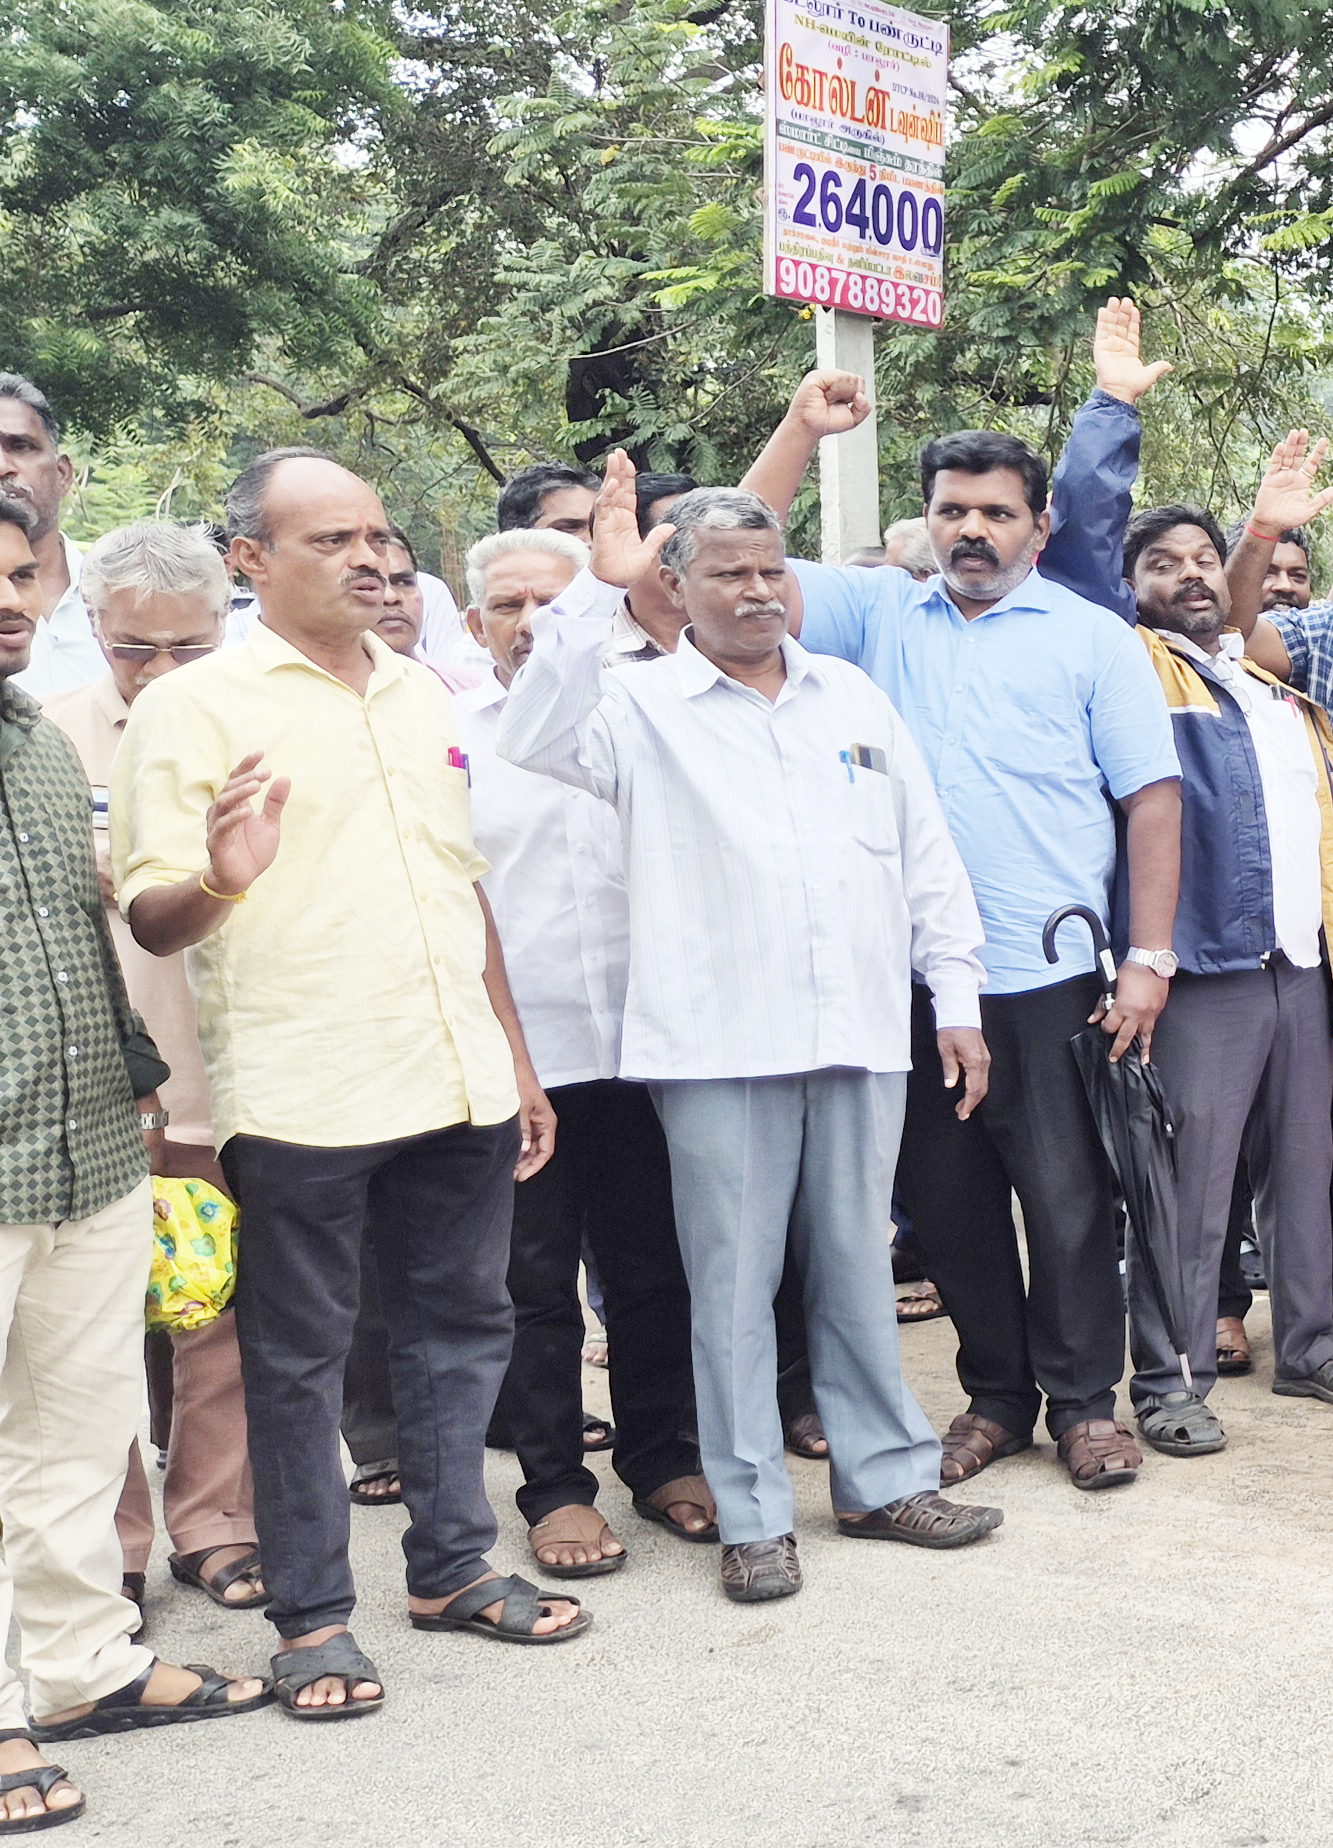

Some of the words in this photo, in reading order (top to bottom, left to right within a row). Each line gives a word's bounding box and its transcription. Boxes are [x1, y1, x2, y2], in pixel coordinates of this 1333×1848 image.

[794, 13, 871, 49] NH-மெயின்
[875, 41, 933, 69] ரோட்டில்
[848, 10, 865, 28] To
[869, 20, 944, 57] பண்ருட்டி
[779, 42, 891, 131] கோல்டன்
[890, 103, 944, 150] டவுன்ஷிப்
[778, 119, 823, 140] ஸ்மார்ட்
[904, 157, 943, 180] தரத்தில்
[790, 108, 835, 129] (பாலூர்
[839, 122, 886, 145] அருகில்)
[835, 157, 867, 177] இருந்து
[869, 164, 877, 182] 5
[779, 258, 942, 326] 9087889320
[836, 253, 845, 265] &
[893, 265, 942, 289] இலவசம்!
